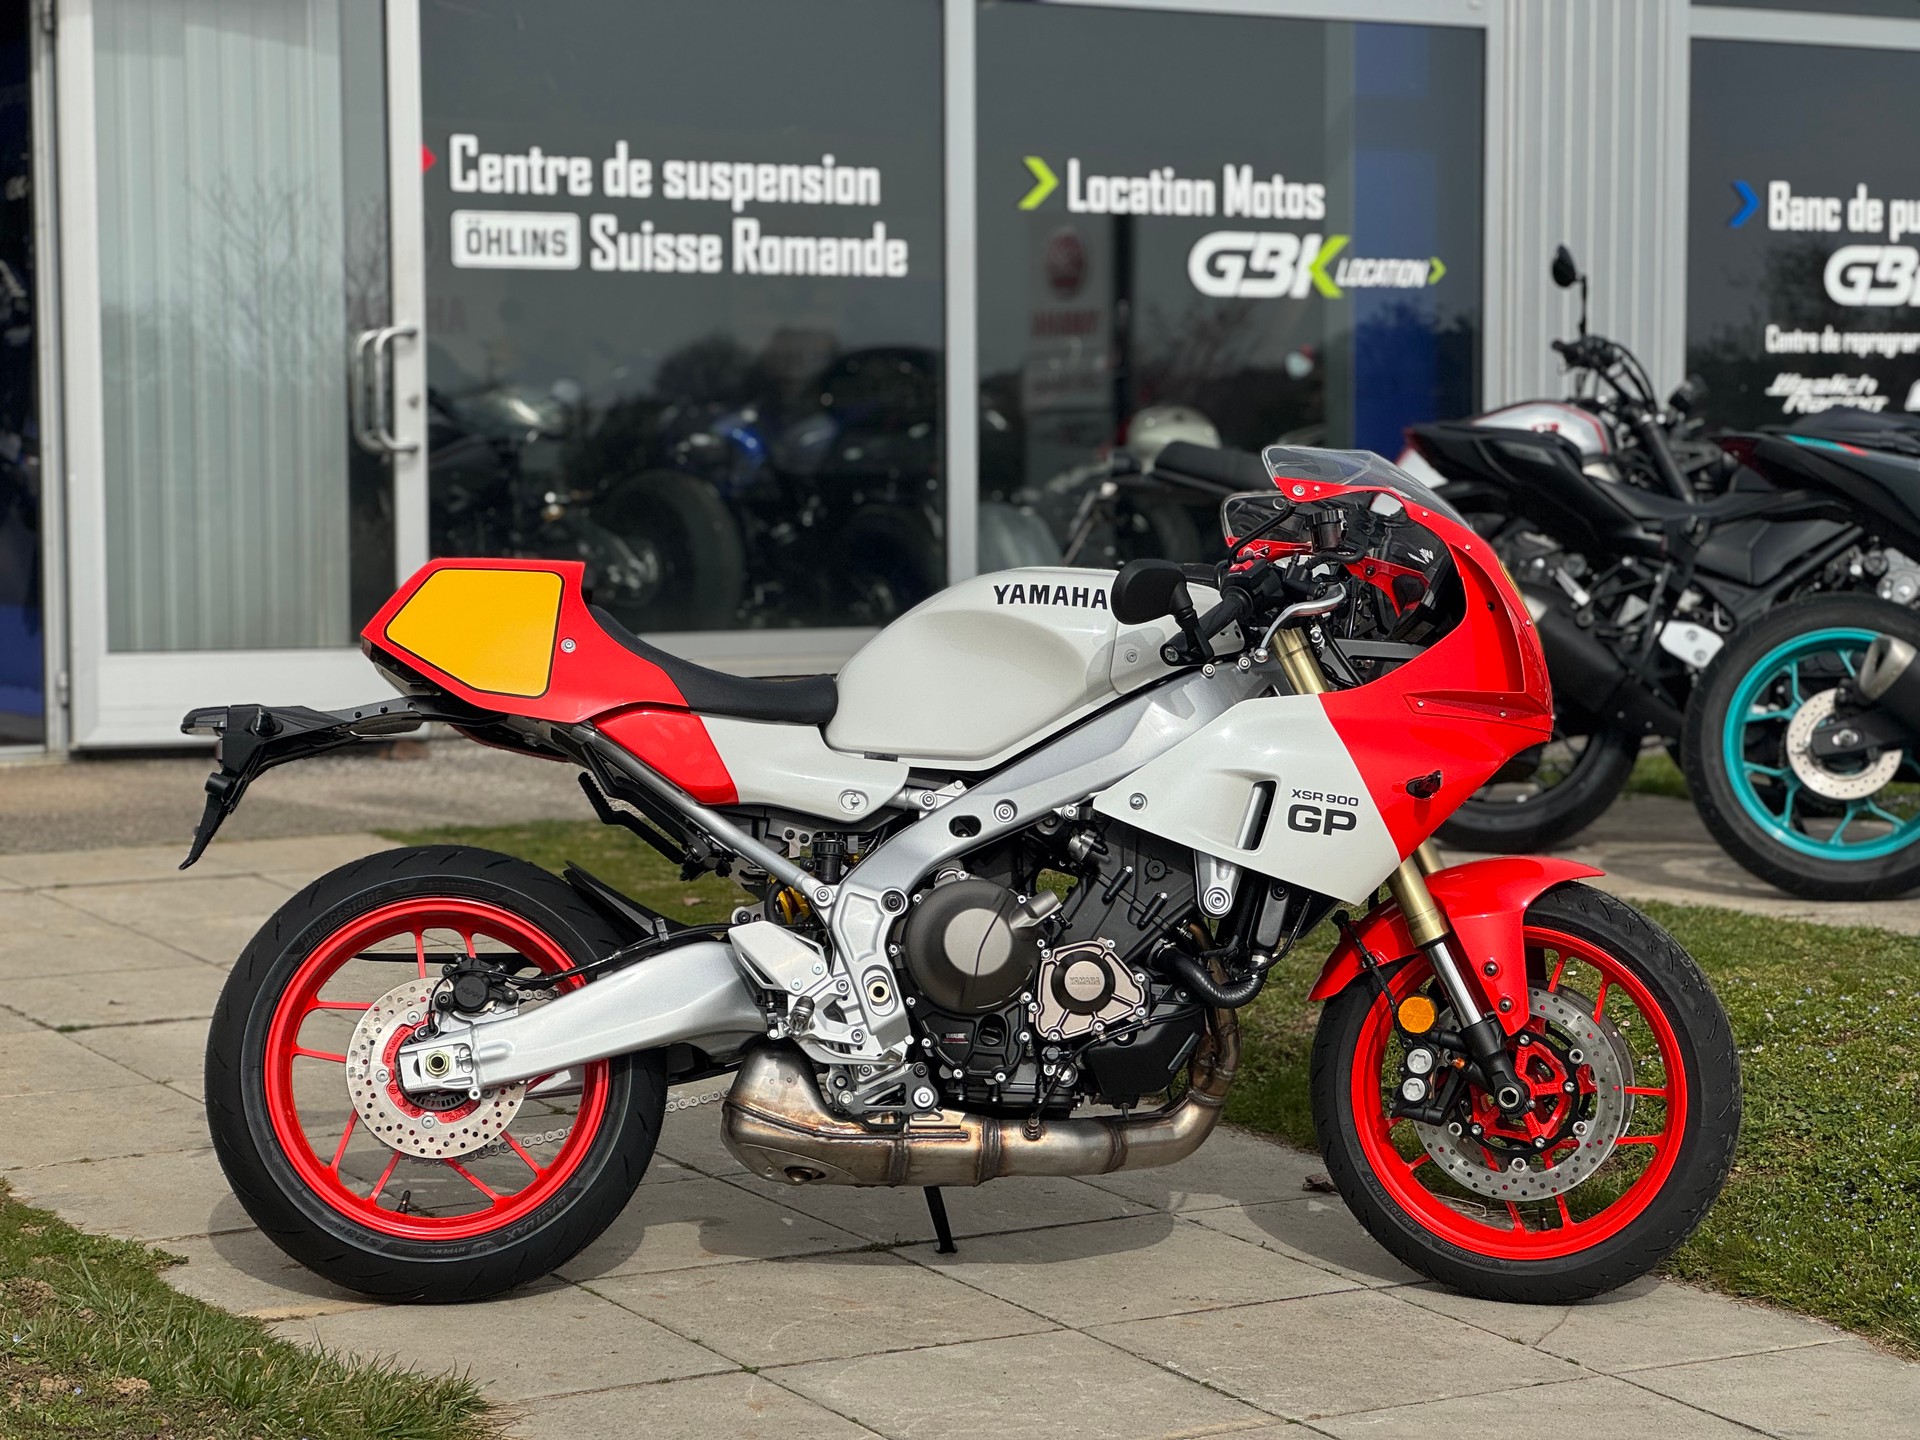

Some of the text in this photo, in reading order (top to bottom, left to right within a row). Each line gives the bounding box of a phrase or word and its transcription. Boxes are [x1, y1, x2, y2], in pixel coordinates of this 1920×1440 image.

[449, 133, 881, 213] Centre de suspension
[1067, 157, 1326, 220] Location Motos
[1767, 180, 1843, 232] Banc
[1847, 183, 1885, 233] de
[465, 218, 569, 257] ÖHLINS
[589, 213, 908, 278] Suisse Romande
[1187, 230, 1350, 300] GBK
[1334, 256, 1431, 289] LOCATION
[1823, 244, 1920, 307] GB
[993, 584, 1108, 610] YAMAHA
[1287, 803, 1358, 836] GP
[1291, 788, 1359, 807] XSR 900
[1069, 976, 1101, 986] YAMAHA
